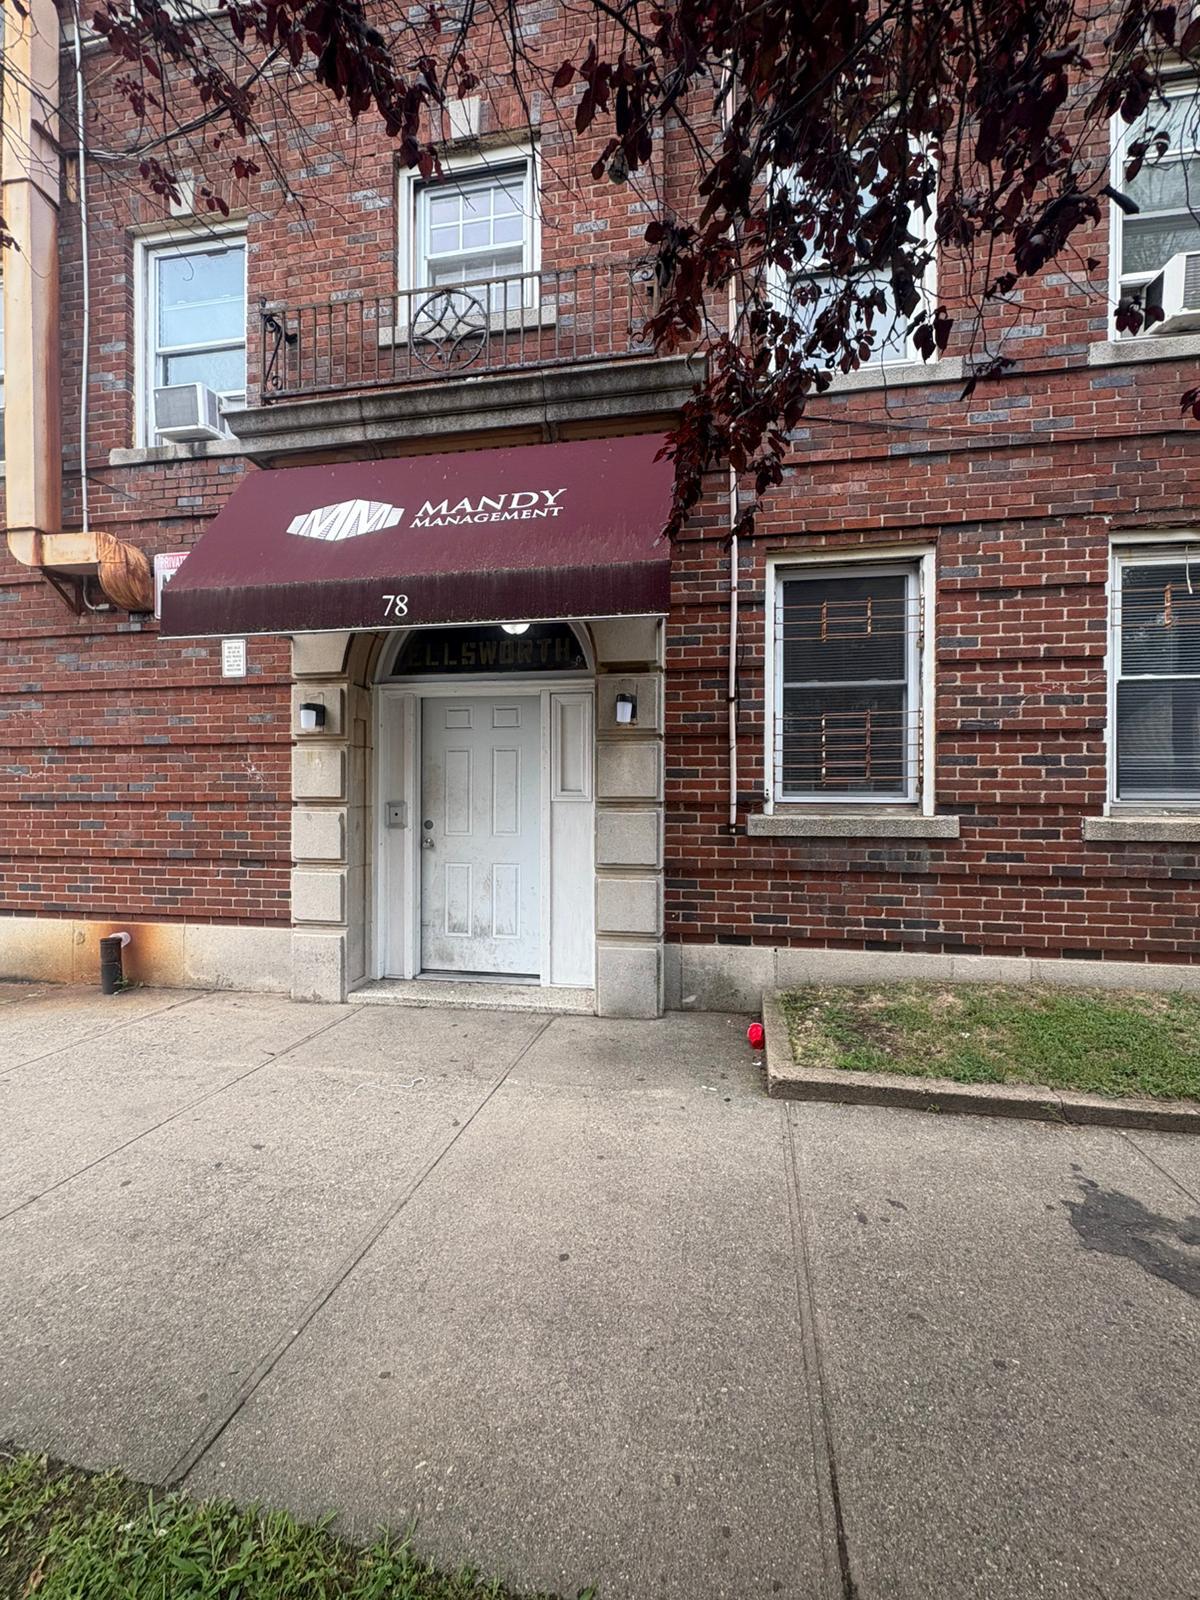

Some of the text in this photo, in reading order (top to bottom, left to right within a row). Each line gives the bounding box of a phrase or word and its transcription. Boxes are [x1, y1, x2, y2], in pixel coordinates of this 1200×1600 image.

[414, 488, 567, 517] MANDY
[409, 506, 564, 528] MANAGEMENT
[159, 555, 188, 569] PRIVAT
[382, 594, 409, 617] 78
